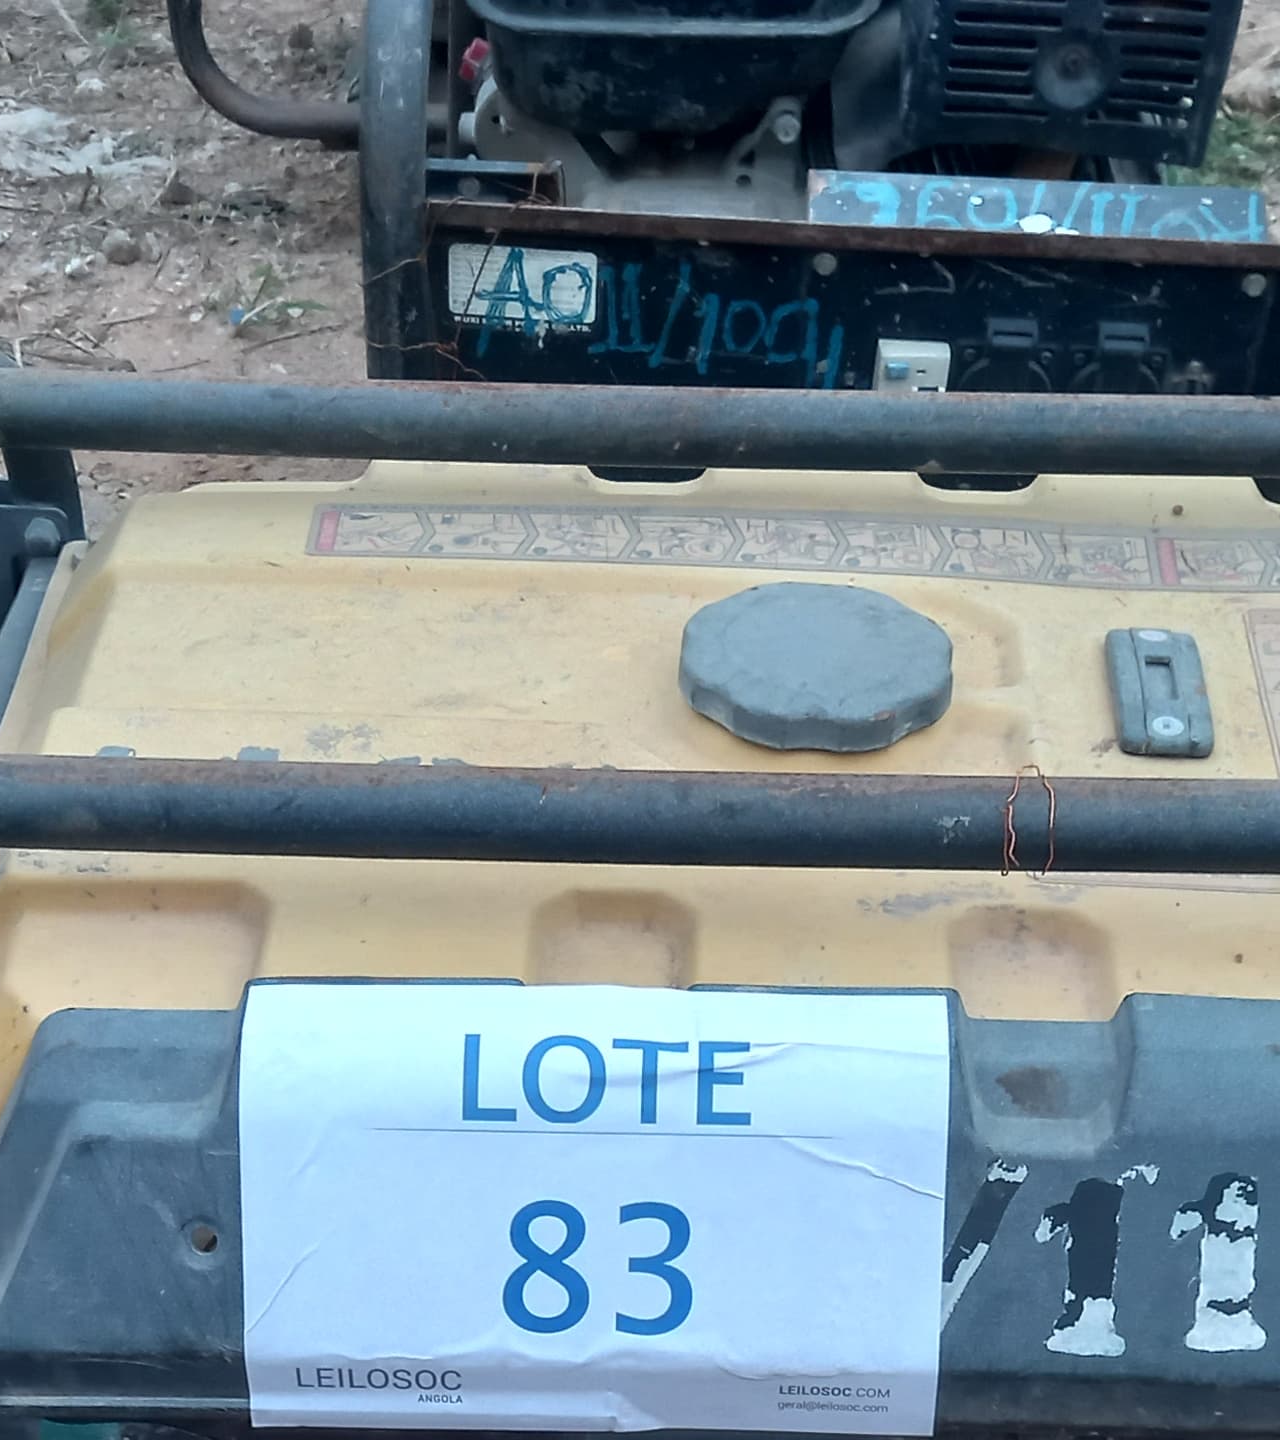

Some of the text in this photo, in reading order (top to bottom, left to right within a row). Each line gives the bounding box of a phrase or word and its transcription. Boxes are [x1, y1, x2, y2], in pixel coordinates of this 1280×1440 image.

[462, 1033, 752, 1126] LOTE
[502, 1199, 693, 1336] 83
[296, 1367, 462, 1391] LEILOSOC
[417, 1394, 463, 1404] ANGOLA
[777, 1401, 889, 1413] geral@leilosoc.com
